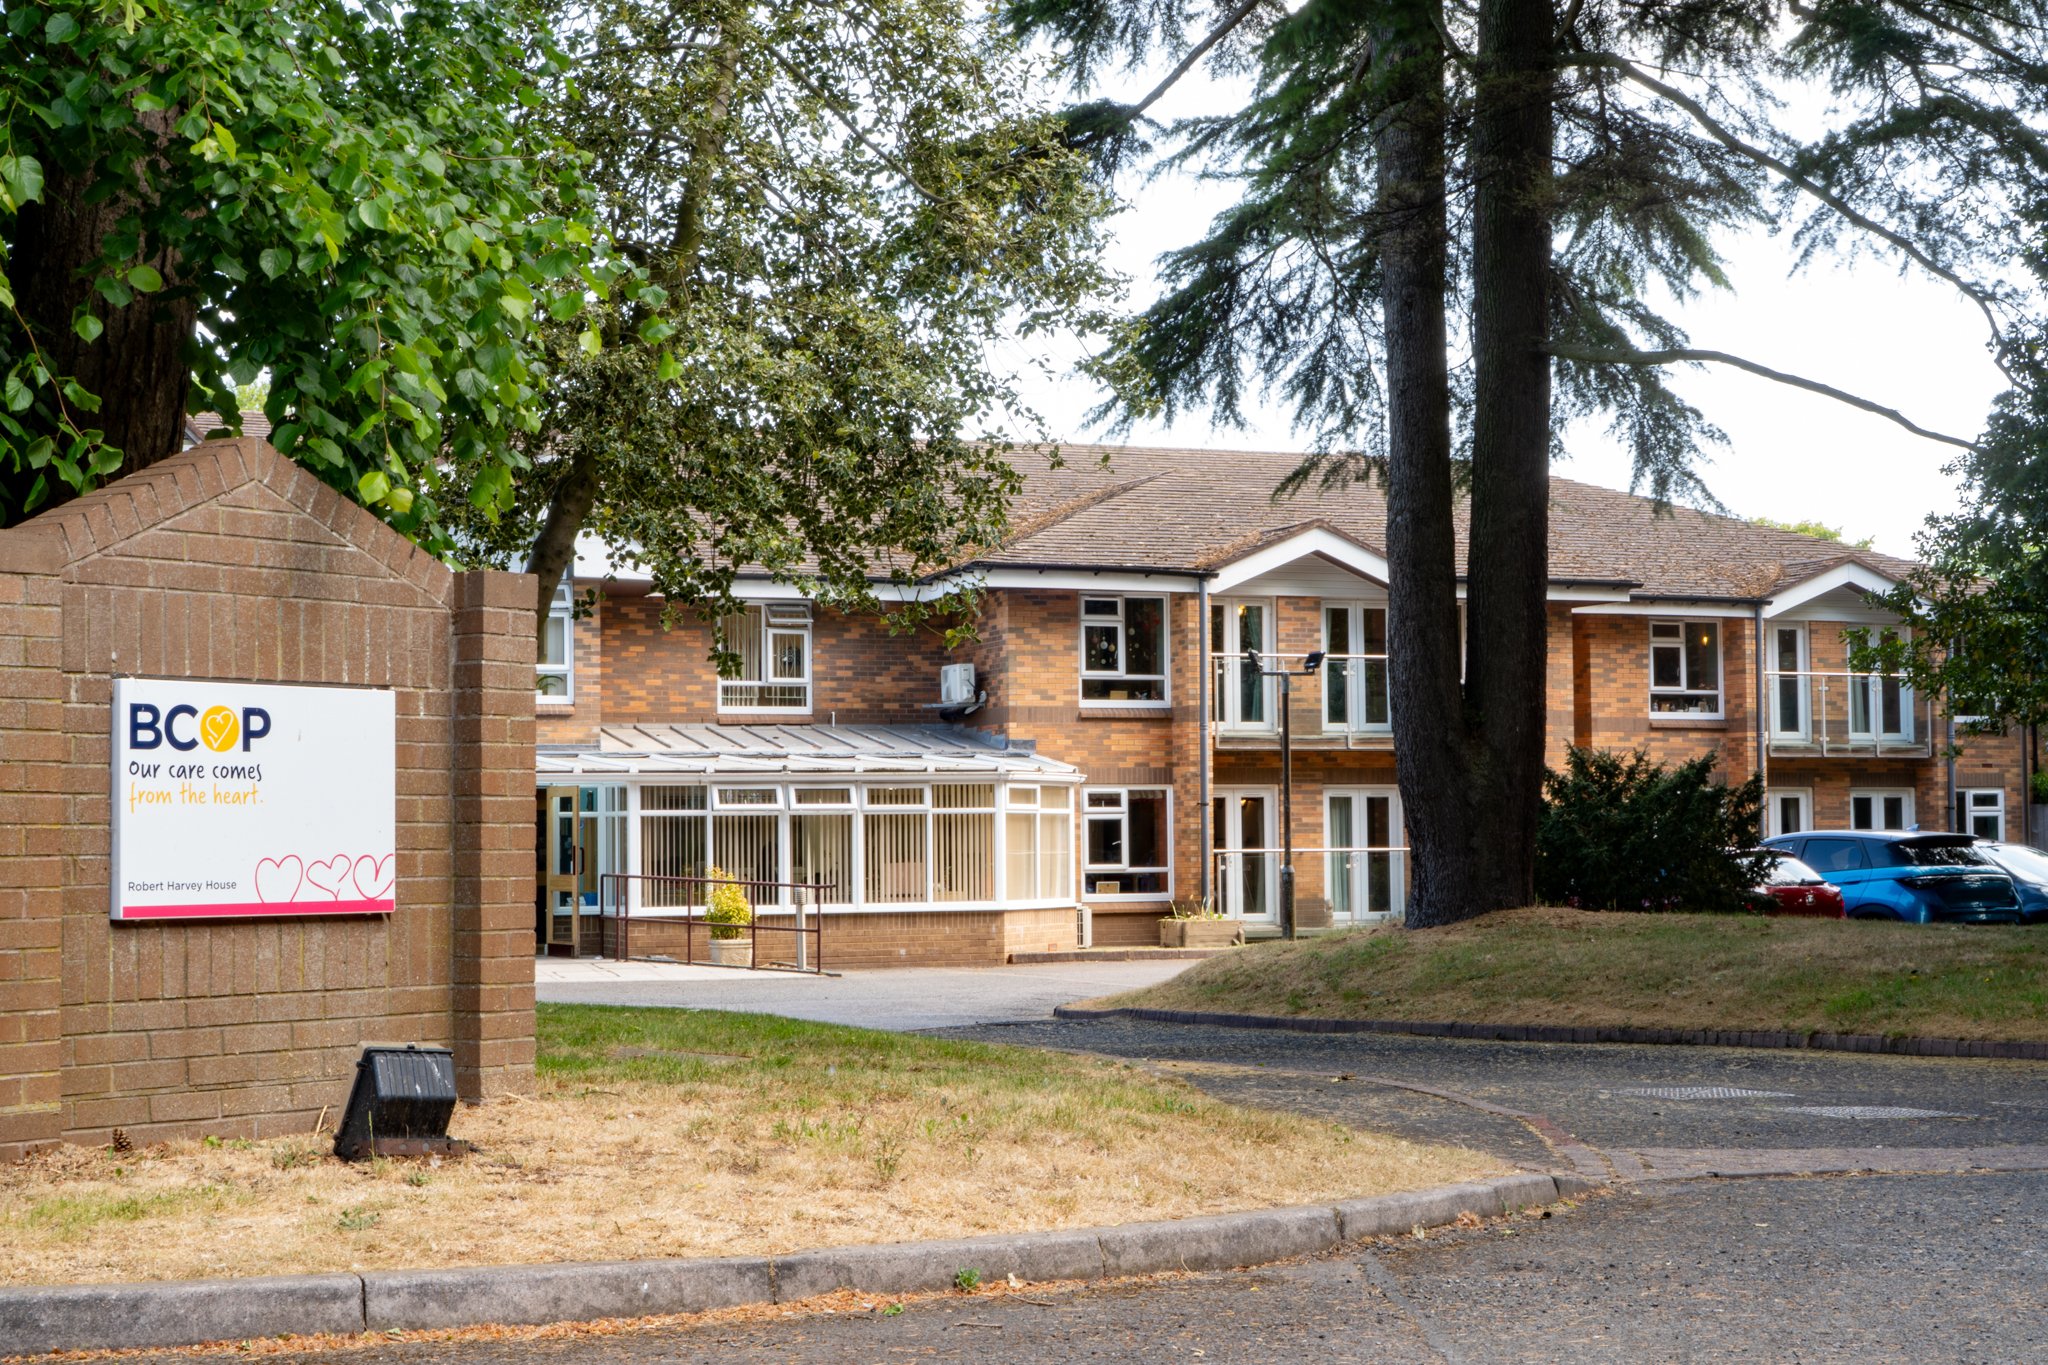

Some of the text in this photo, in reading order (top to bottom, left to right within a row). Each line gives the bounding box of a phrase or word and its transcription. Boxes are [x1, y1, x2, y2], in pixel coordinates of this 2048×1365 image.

[129, 760, 263, 782] Our care comes
[129, 782, 264, 813] from the heart.
[128, 880, 237, 892] Robert Harvey House
